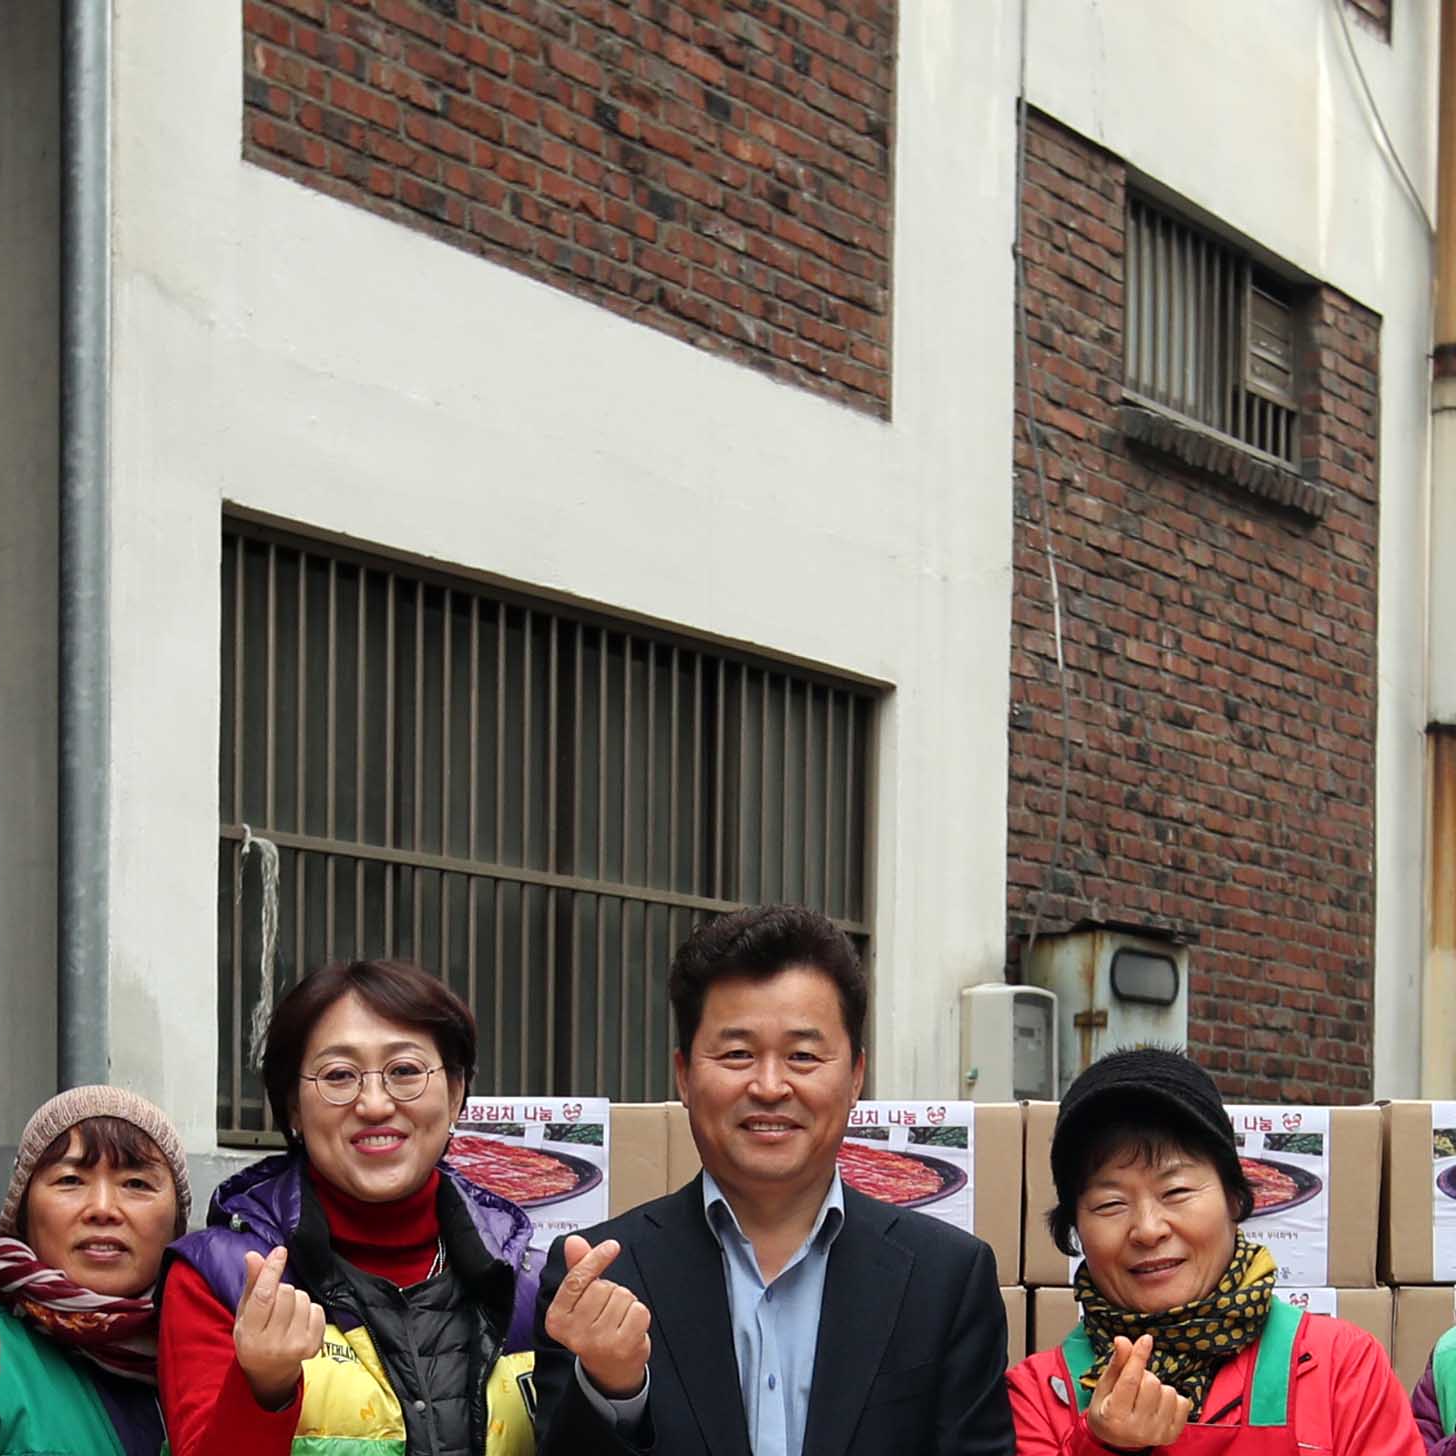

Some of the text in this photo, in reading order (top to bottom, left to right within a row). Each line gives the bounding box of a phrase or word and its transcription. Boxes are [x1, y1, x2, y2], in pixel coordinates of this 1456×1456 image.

[524, 1105, 552, 1121] 나눔
[888, 1109, 916, 1125] 나눔
[1244, 1116, 1272, 1131] 나눔
